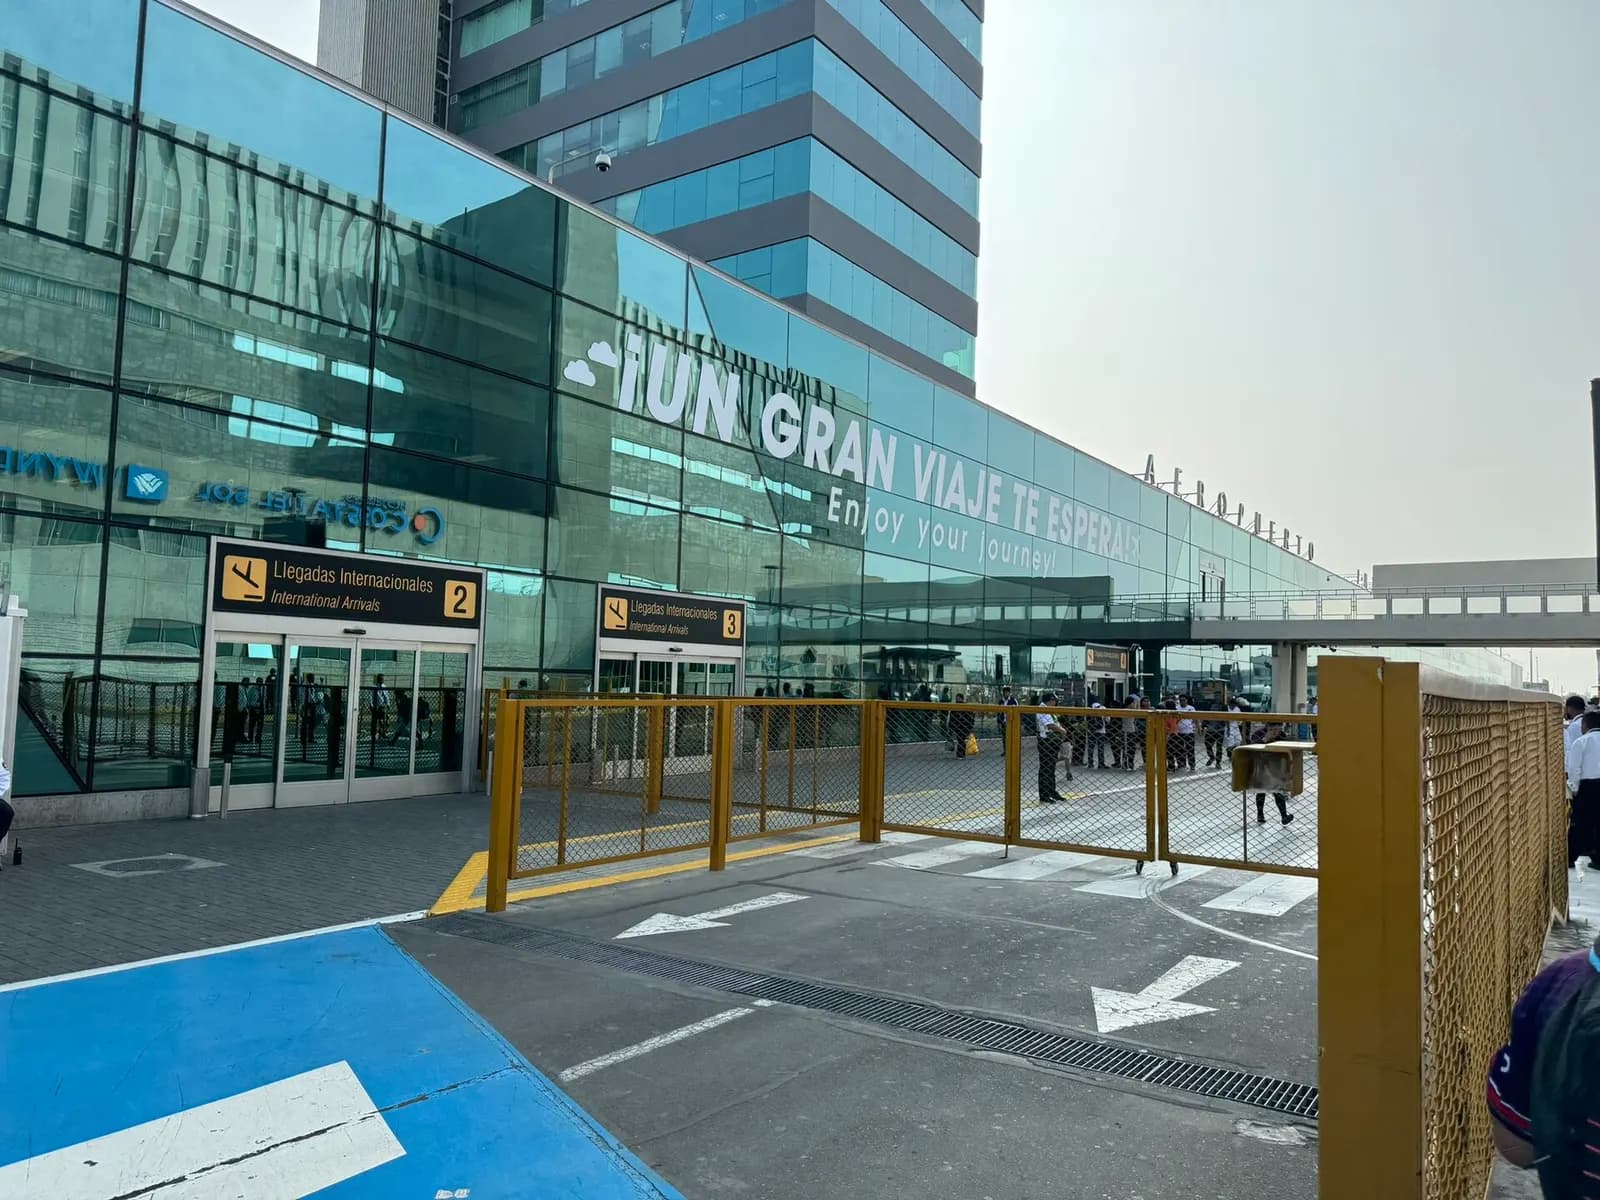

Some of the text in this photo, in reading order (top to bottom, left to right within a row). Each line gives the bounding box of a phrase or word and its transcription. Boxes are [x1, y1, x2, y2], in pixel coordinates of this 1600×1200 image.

[761, 392, 898, 493] GRAN
[913, 443, 1003, 524] VIAJE
[1012, 480, 1041, 536] TE
[1143, 453, 1315, 561] AEROPUERTO
[827, 486, 1057, 579] Enjoy your journey!
[273, 559, 434, 593] Llegadas Internacionales
[270, 589, 381, 613] International Arrivals
[452, 585, 468, 614] 2
[630, 599, 718, 621] Llegadas Internacionales
[629, 621, 689, 636] International Arrivals
[727, 613, 736, 635] 3
